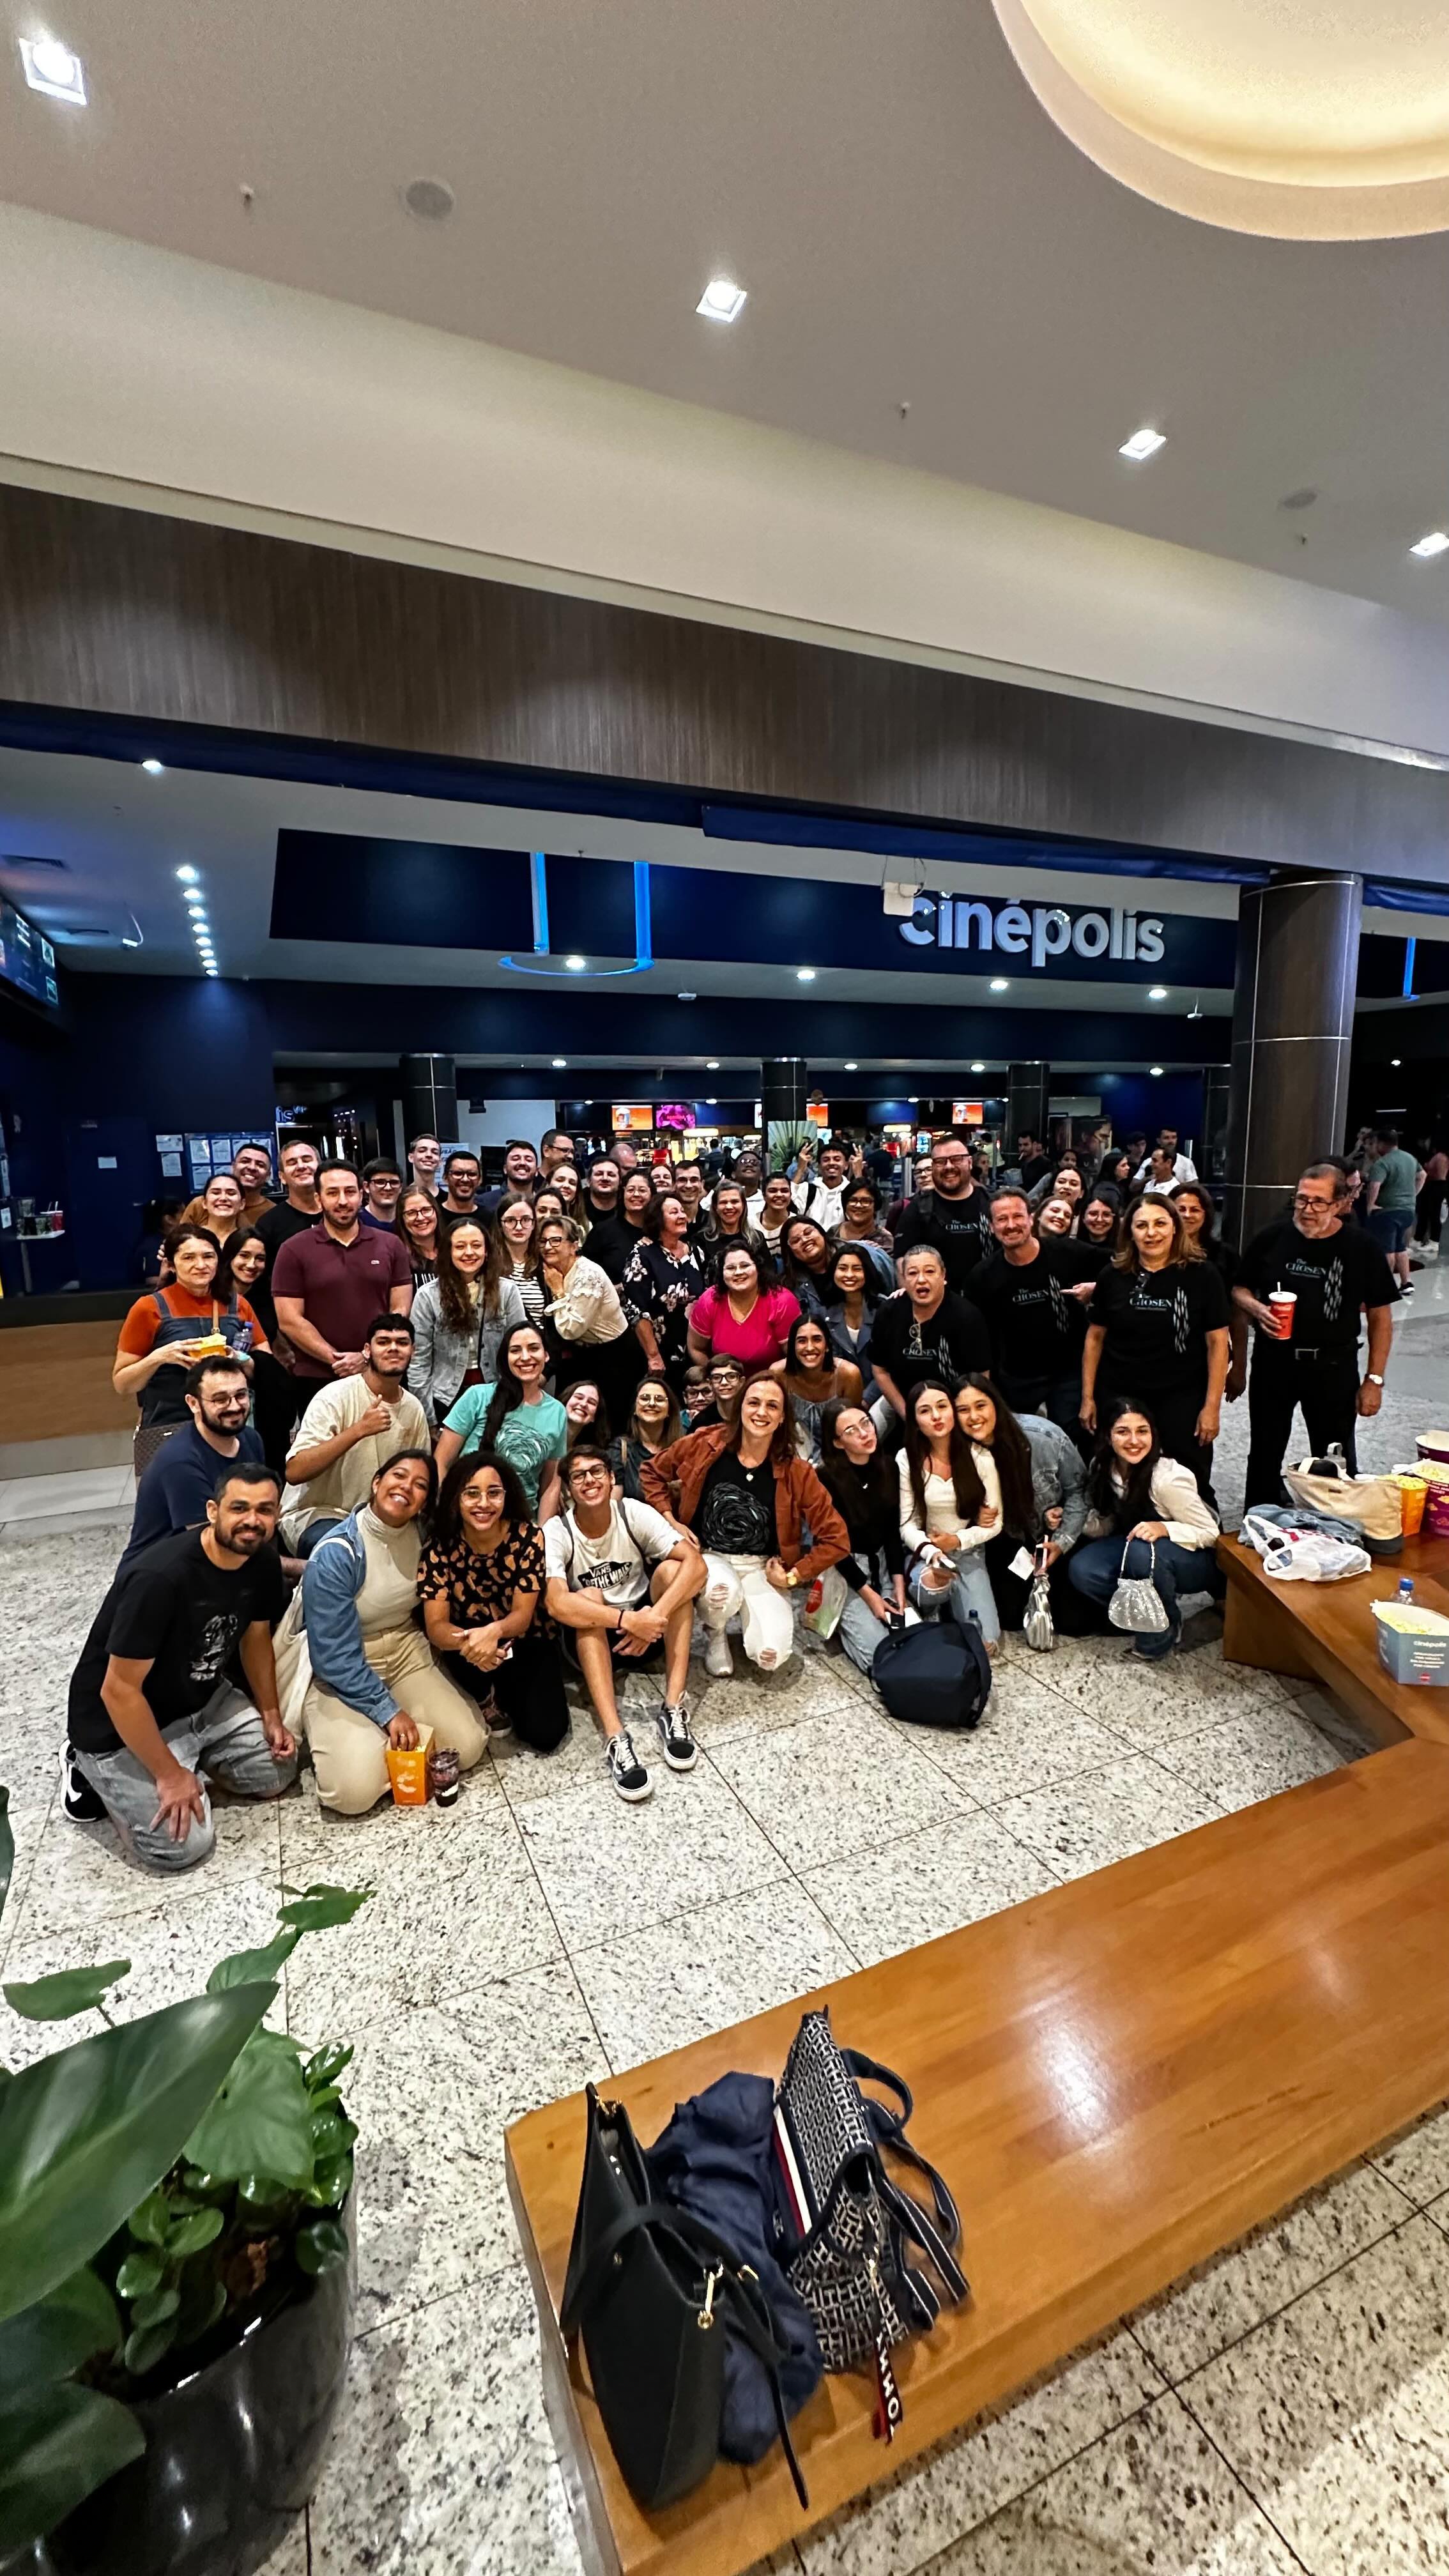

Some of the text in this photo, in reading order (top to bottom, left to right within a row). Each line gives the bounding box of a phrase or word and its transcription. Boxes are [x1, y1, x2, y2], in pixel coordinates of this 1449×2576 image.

[898, 890, 1165, 967] cinépolis
[1285, 1262, 1326, 1275] CHOSEN
[1013, 1289, 1049, 1303] CHOSEN
[1129, 1298, 1172, 1307] CHOSEN
[588, 1562, 612, 1578] VANS
